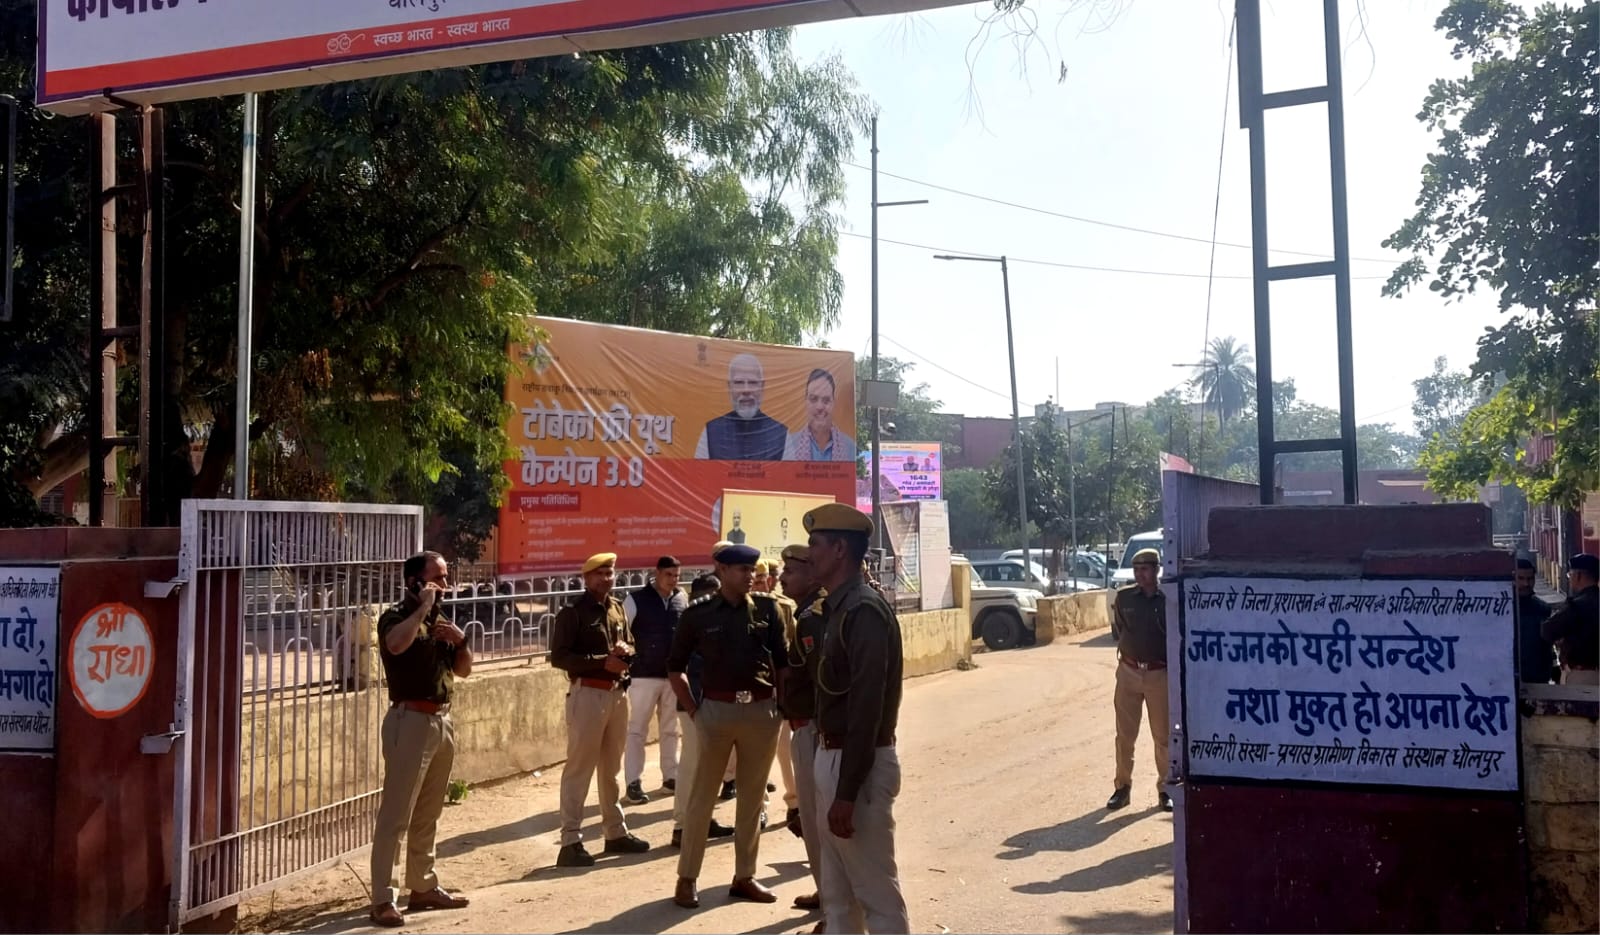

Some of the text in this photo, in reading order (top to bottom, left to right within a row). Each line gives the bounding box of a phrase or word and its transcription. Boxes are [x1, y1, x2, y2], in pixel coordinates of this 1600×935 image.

[373, 31, 403, 47] स्वच्छ
[407, 27, 434, 42] भारत
[446, 22, 478, 37] स्वस्थ
[482, 17, 511, 32] भारत
[520, 398, 675, 456] टोबेको फ्री यूथ
[520, 445, 645, 488] कैम्पेन 3.0
[1188, 583, 1226, 611] सौजन्य
[1225, 585, 1240, 612] से
[1241, 585, 1274, 612] जिला
[1271, 592, 1315, 615] प्रशासन
[1386, 586, 1454, 616] अधिकारिता
[1452, 588, 1493, 616] विभाग
[95, 605, 129, 639] श्री
[87, 644, 146, 684] राधा
[1266, 618, 1299, 667] को
[1300, 617, 1357, 674] यही
[1358, 618, 1461, 676] सन्देश
[1225, 680, 1511, 738] नशा मुक्त हो अपना देश
[1189, 732, 1238, 764] कार्यकारी
[1276, 743, 1314, 768] प्रयास
[1313, 736, 1357, 766] ग्रामीण
[1356, 737, 1402, 768] विकास
[1402, 741, 1451, 769] संस्थान
[1452, 741, 1507, 779] धौलपुर
